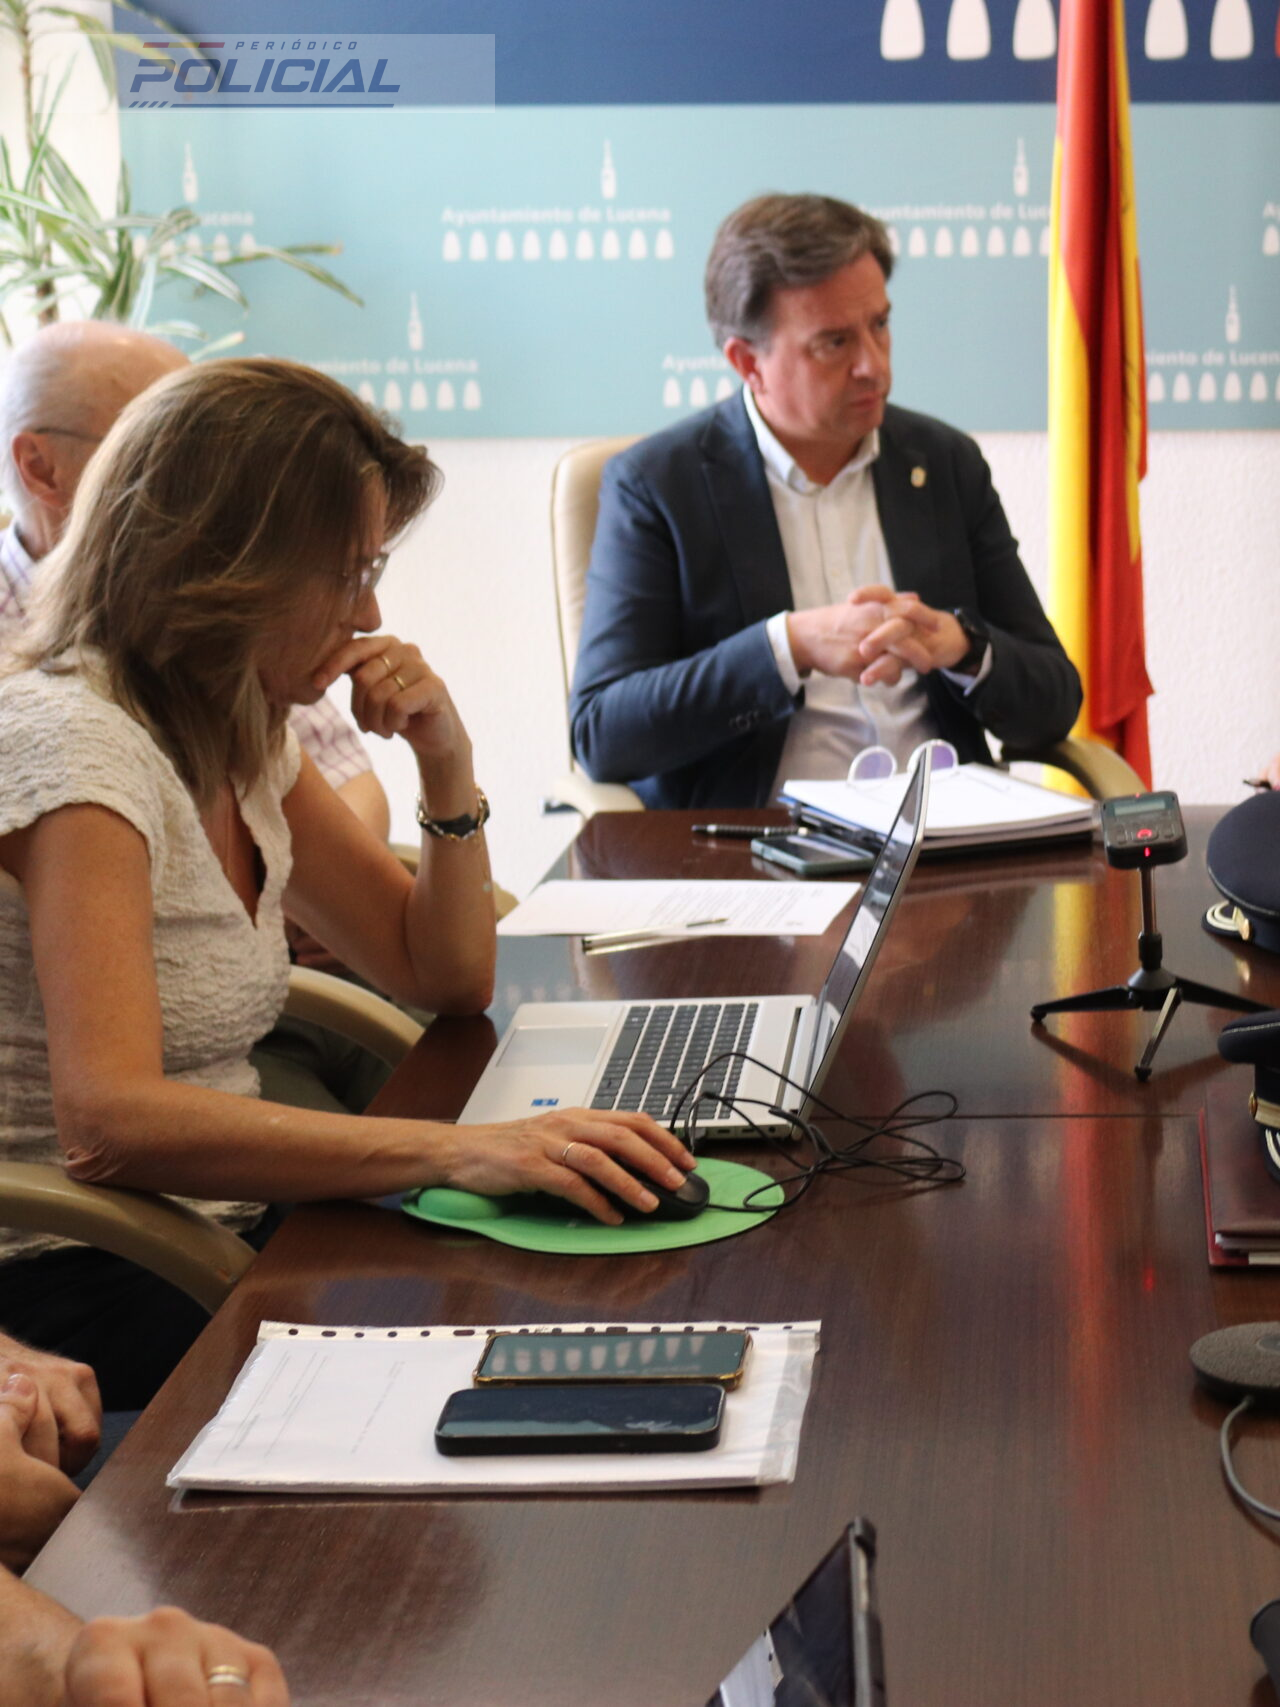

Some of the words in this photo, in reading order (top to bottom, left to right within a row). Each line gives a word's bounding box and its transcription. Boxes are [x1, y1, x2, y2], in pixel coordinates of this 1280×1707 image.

[442, 206, 574, 227] Ayuntamiento
[578, 206, 600, 223] de
[606, 206, 671, 223] Lucena
[990, 203, 1013, 220] de
[385, 358, 408, 374] de
[415, 358, 478, 373] Lucena
[1202, 350, 1224, 366] de
